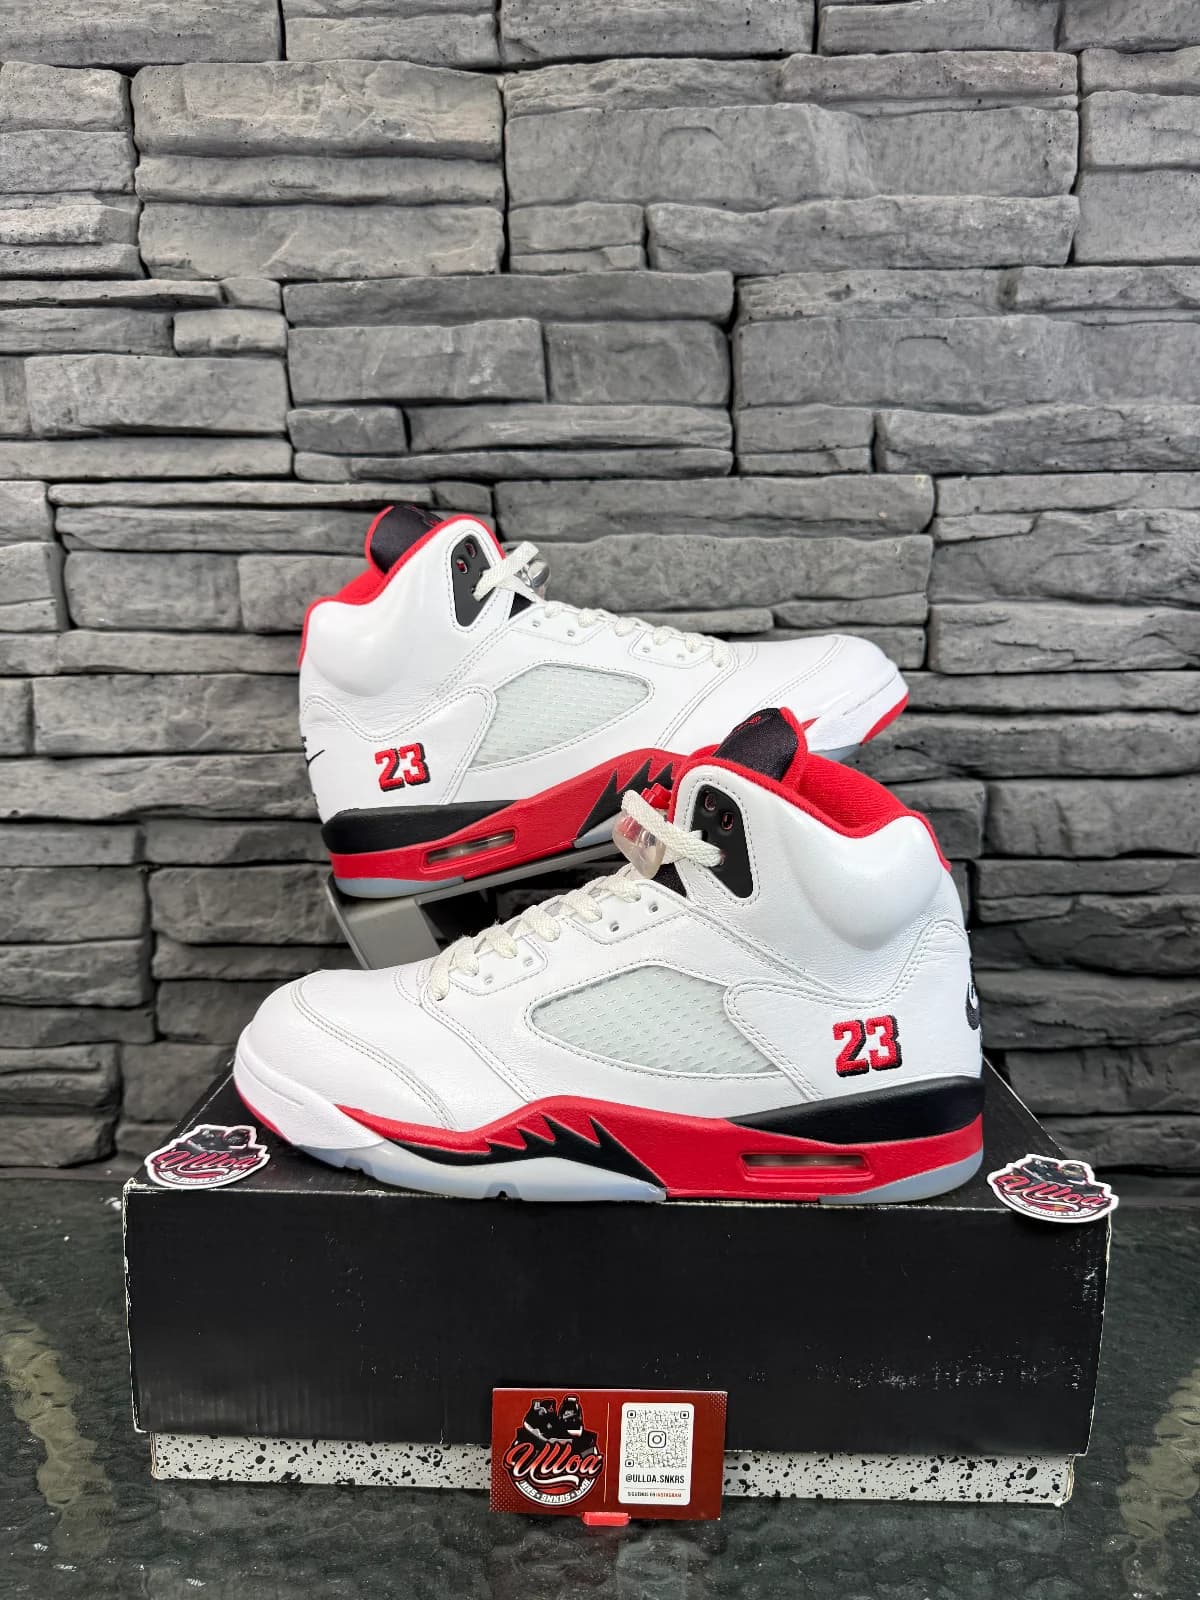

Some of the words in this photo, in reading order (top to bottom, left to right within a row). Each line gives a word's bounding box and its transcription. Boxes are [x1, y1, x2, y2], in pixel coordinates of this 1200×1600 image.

[375, 743, 431, 792] 23
[833, 1015, 902, 1077] 23
[156, 1150, 260, 1170] Ulloa
[997, 1175, 1111, 1208] Ulloa
[506, 1442, 603, 1476] Ulloa
[625, 1473, 685, 1484] @ULLOA.SNKRS
